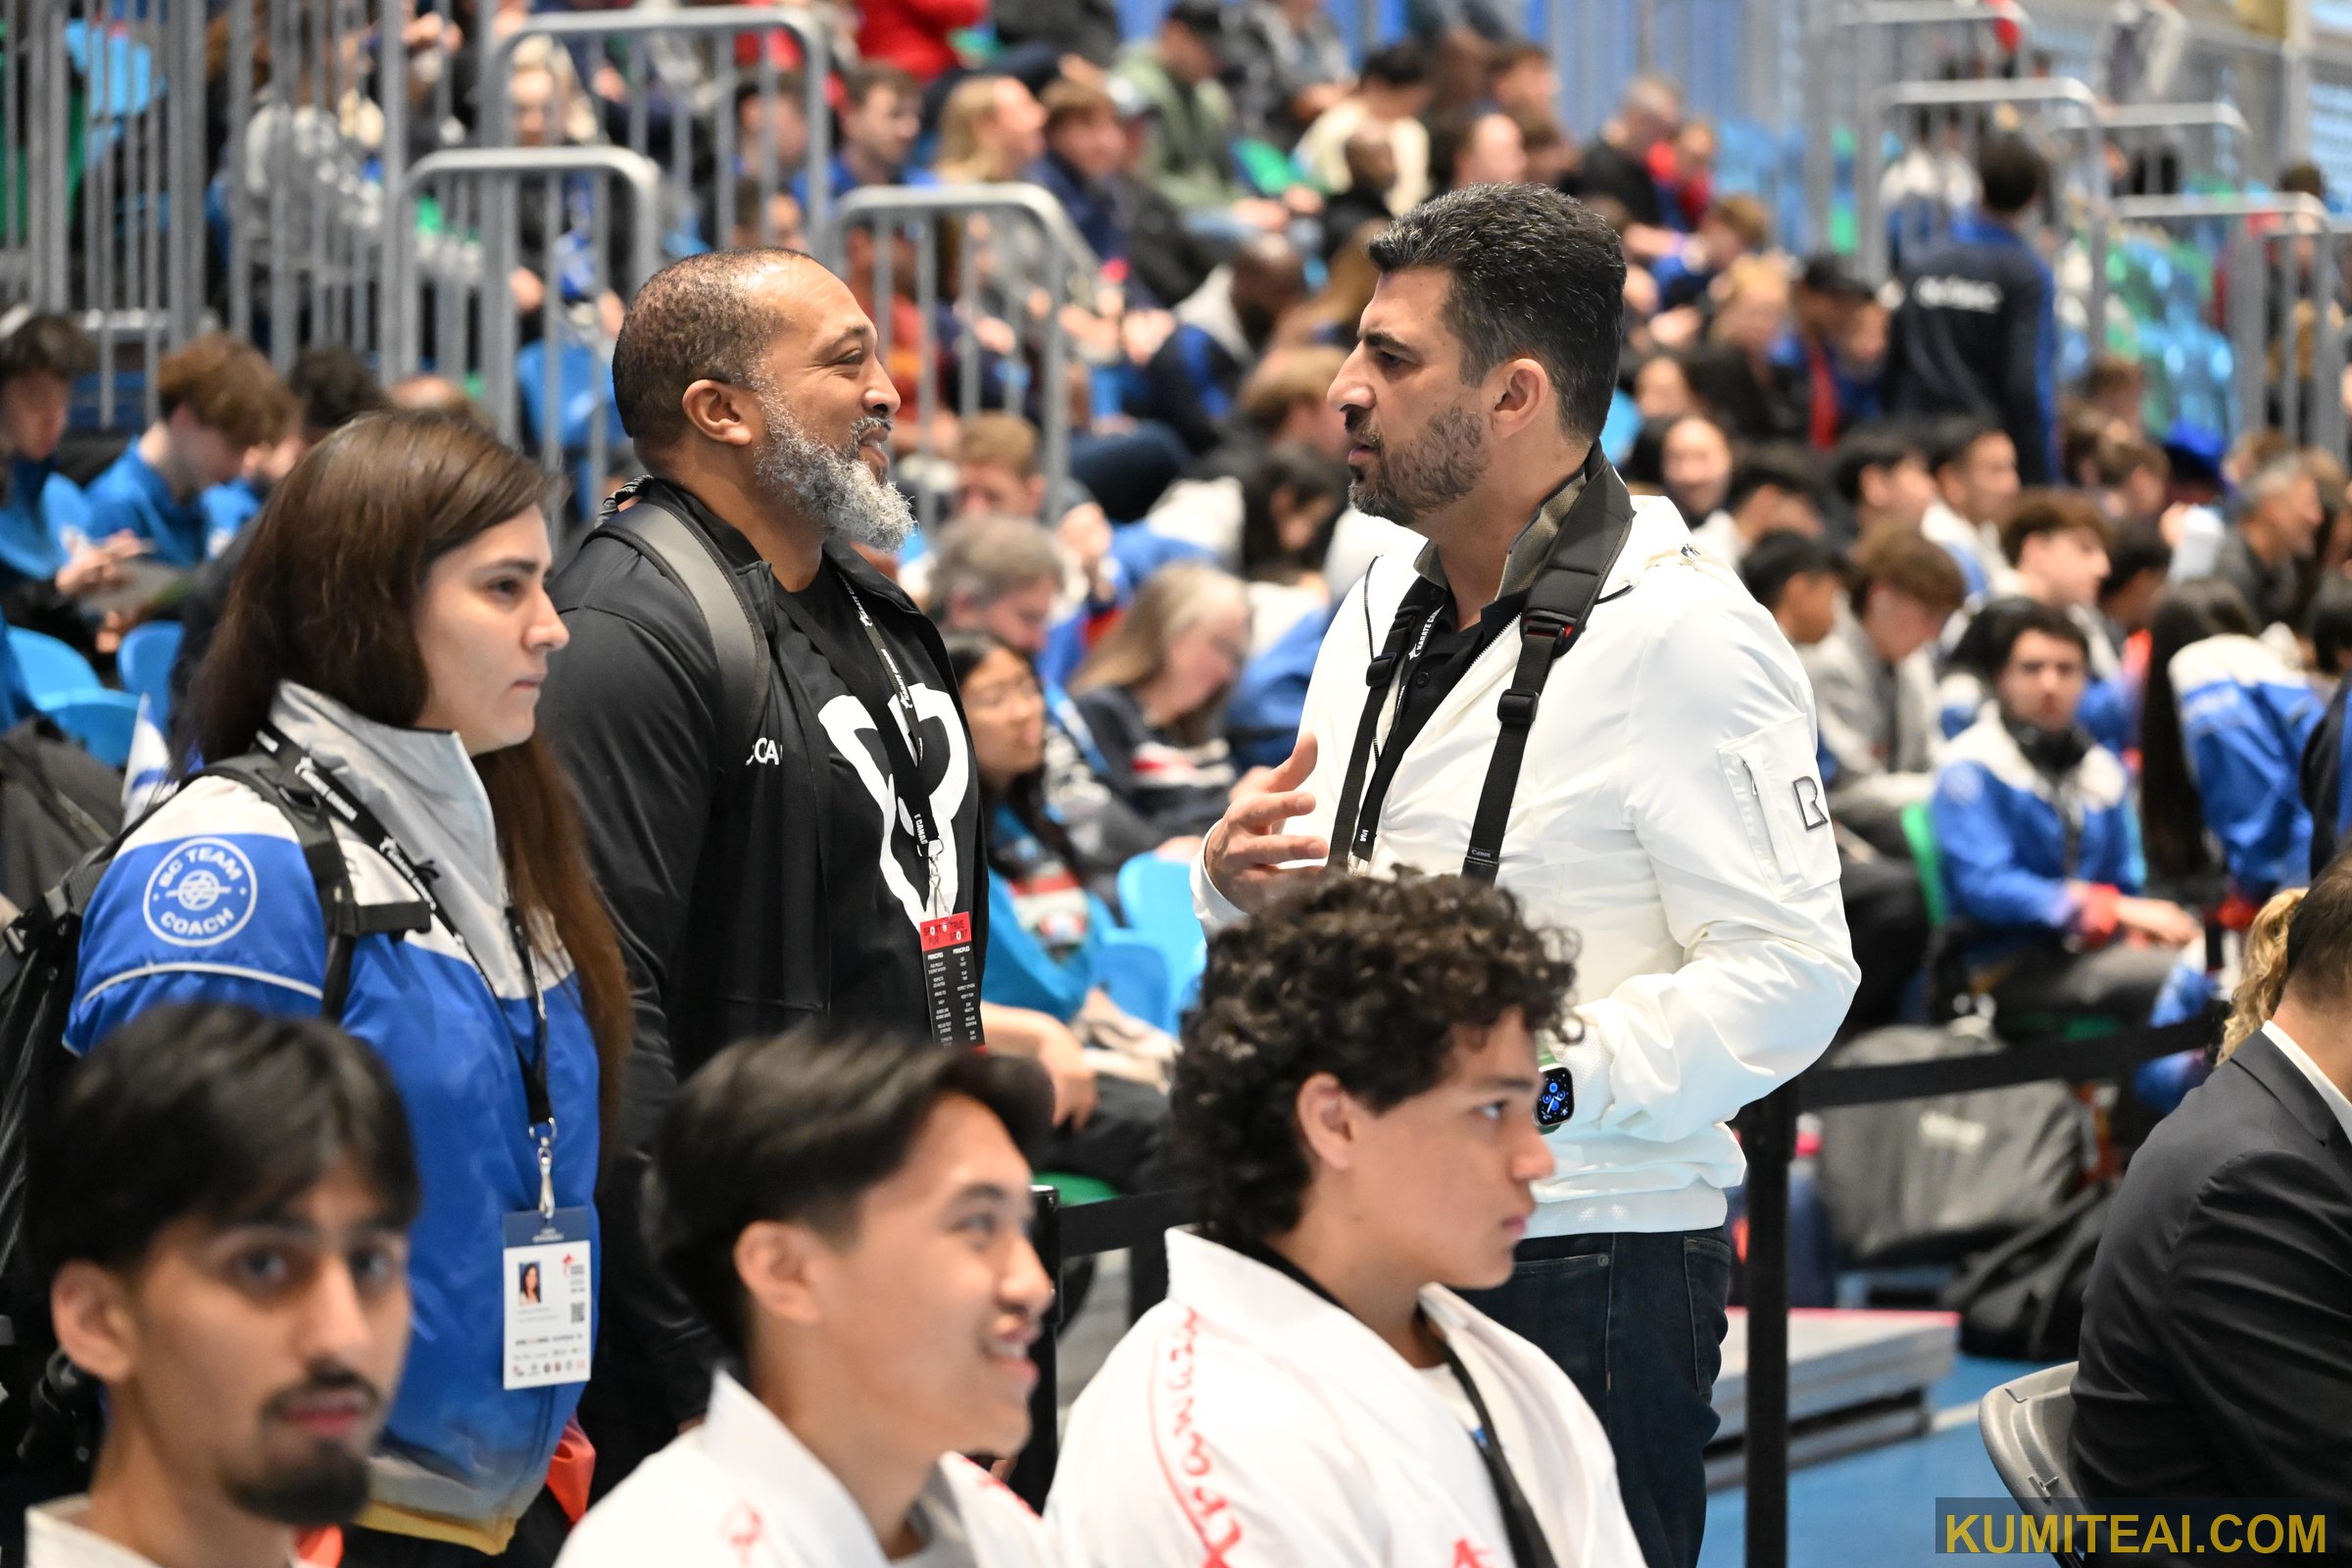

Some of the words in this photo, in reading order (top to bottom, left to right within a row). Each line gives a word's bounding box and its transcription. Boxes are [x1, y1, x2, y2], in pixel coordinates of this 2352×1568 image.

[1416, 622, 1432, 651] KARATE
[159, 858, 183, 888] BC
[185, 847, 243, 881] TEAM
[160, 906, 234, 936] COACH
